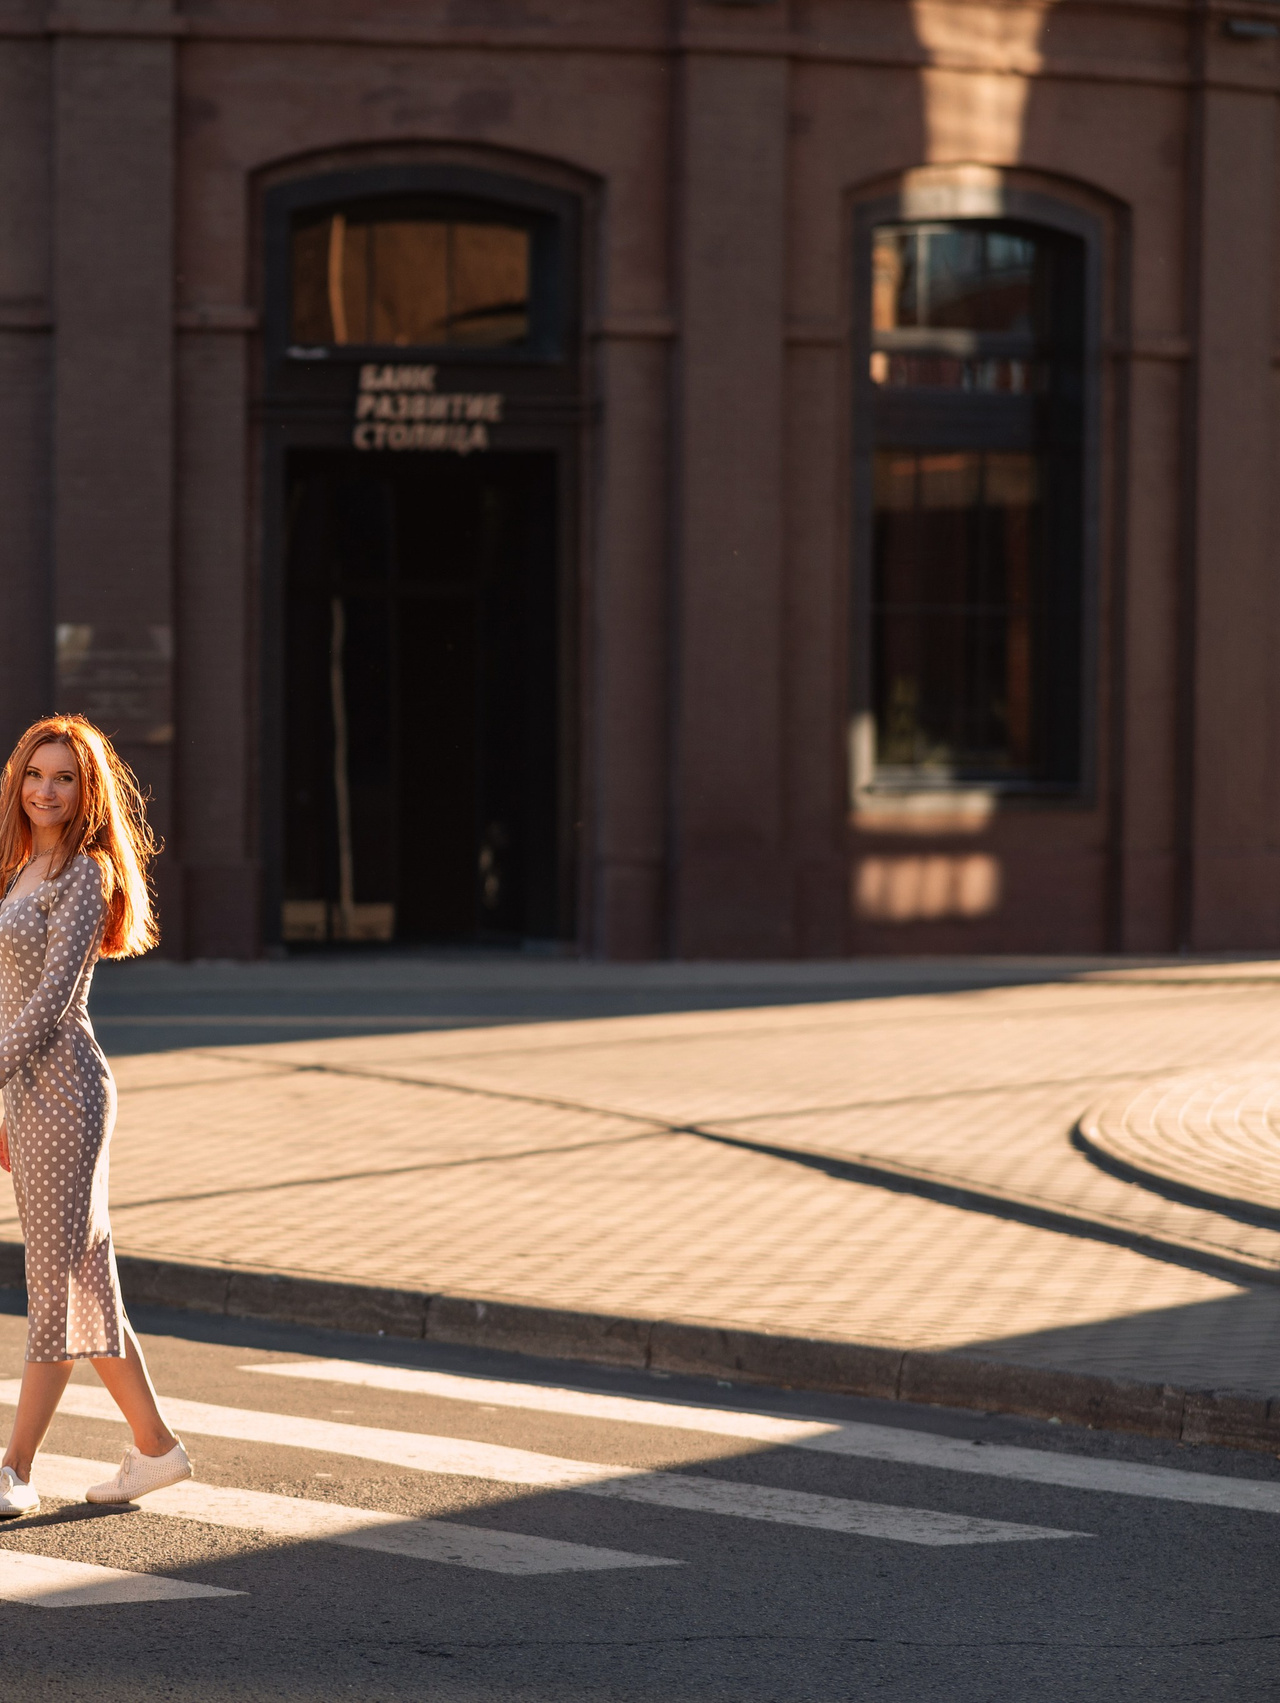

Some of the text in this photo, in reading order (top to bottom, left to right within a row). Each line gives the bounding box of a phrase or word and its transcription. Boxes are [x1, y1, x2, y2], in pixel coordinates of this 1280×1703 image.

[359, 365, 437, 391] БАНК
[356, 394, 503, 422] РАЗВИТИЕ
[354, 423, 488, 456] СТОЛИЦА
